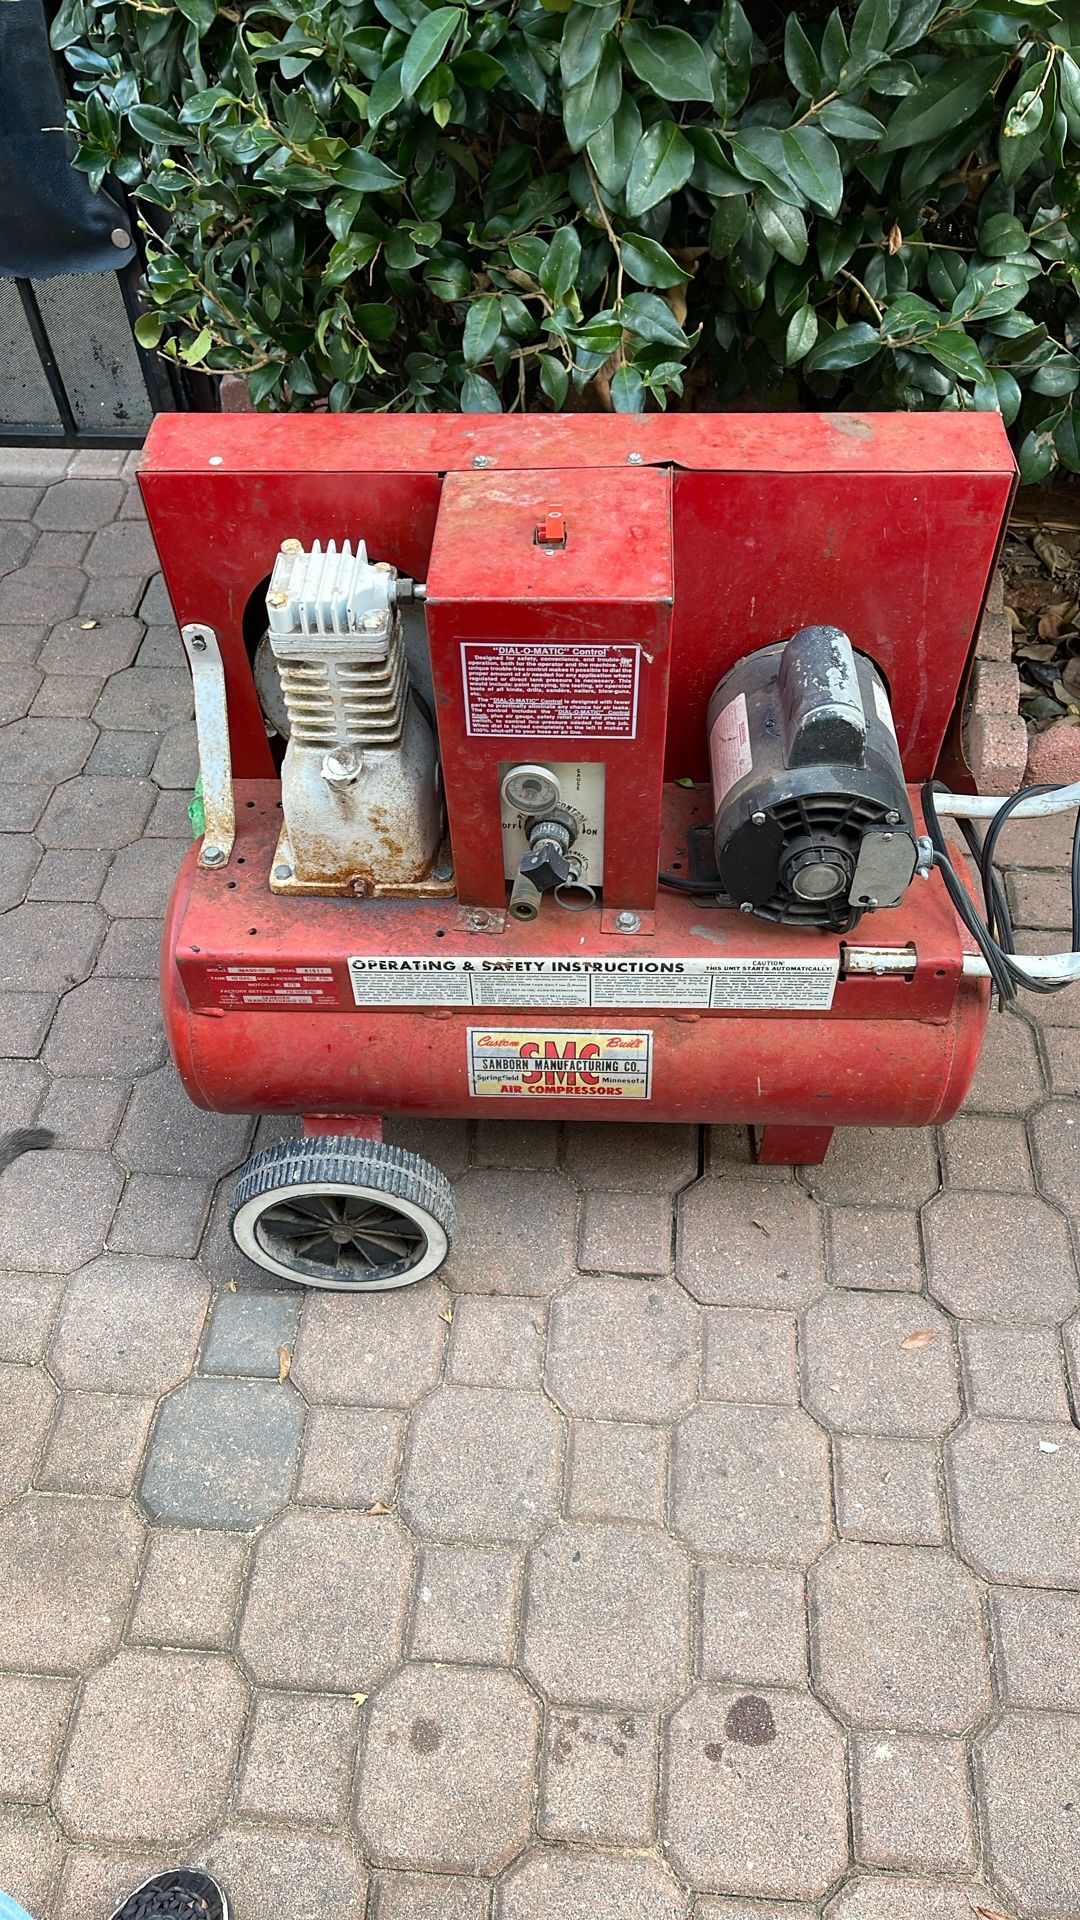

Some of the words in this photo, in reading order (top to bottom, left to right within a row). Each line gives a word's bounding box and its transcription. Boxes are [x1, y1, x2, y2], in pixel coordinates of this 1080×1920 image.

[493, 647, 570, 655] "DIAL-O-MATIC"
[572, 648, 606, 656] Control
[462, 961, 476, 971] &
[482, 960, 545, 972] SAFETY
[551, 962, 685, 973] INSTRUCTIONS
[477, 1036, 520, 1047] Custom
[606, 1037, 643, 1049] Built
[482, 1059, 529, 1070] SANBORN
[535, 1059, 619, 1072] MANUFACTURING
[624, 1061, 640, 1072] CO.
[519, 1041, 600, 1086] SMC
[476, 1074, 519, 1083] Springfield
[500, 1085, 521, 1093] AIR
[527, 1085, 623, 1095] COMPRESSORS
